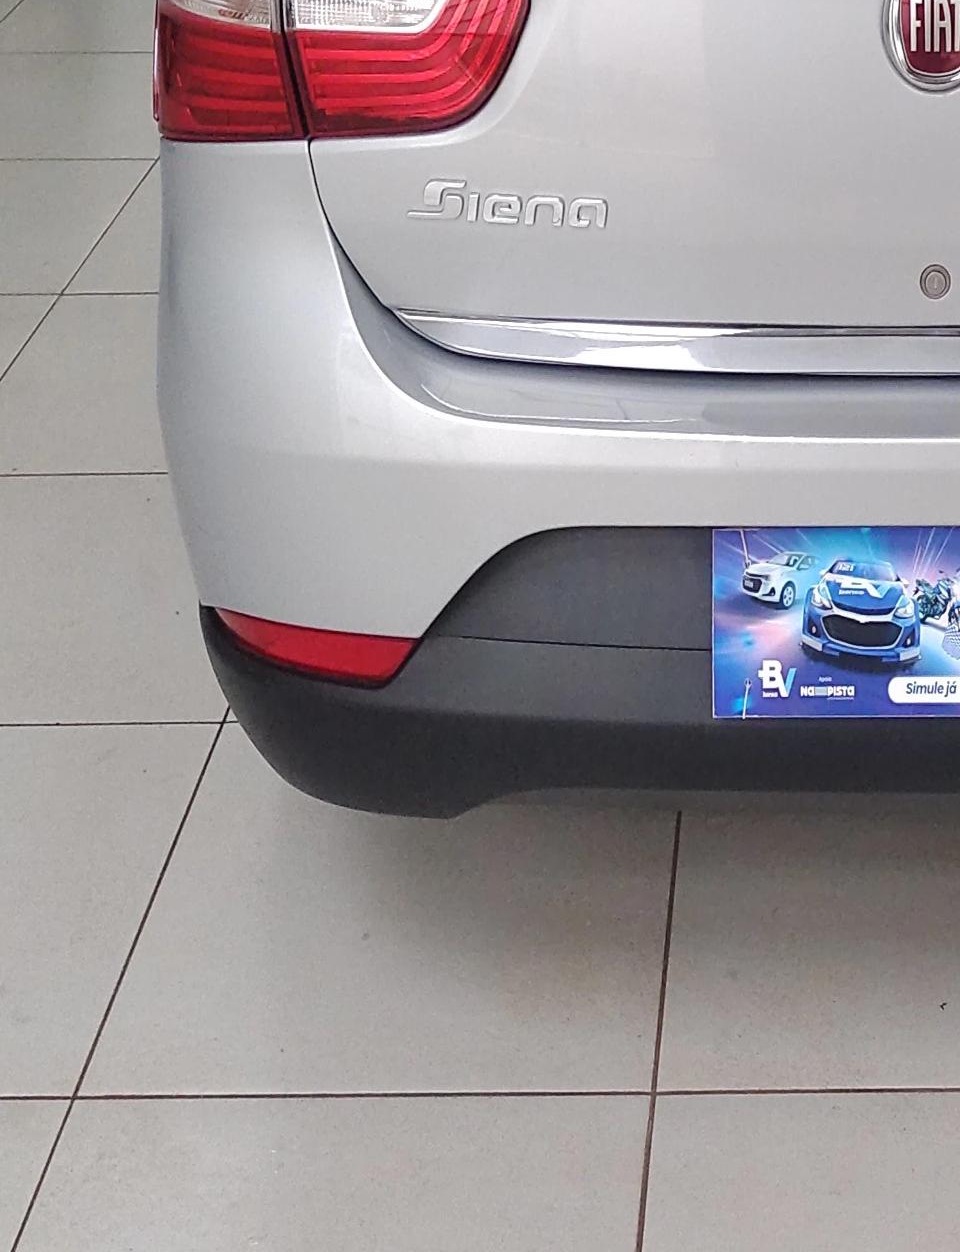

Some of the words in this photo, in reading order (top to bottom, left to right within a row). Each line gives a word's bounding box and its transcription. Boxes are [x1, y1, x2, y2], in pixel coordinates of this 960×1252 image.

[406, 178, 608, 229] Siena
[905, 681, 944, 695] Simule
[943, 680, 958, 698] já
